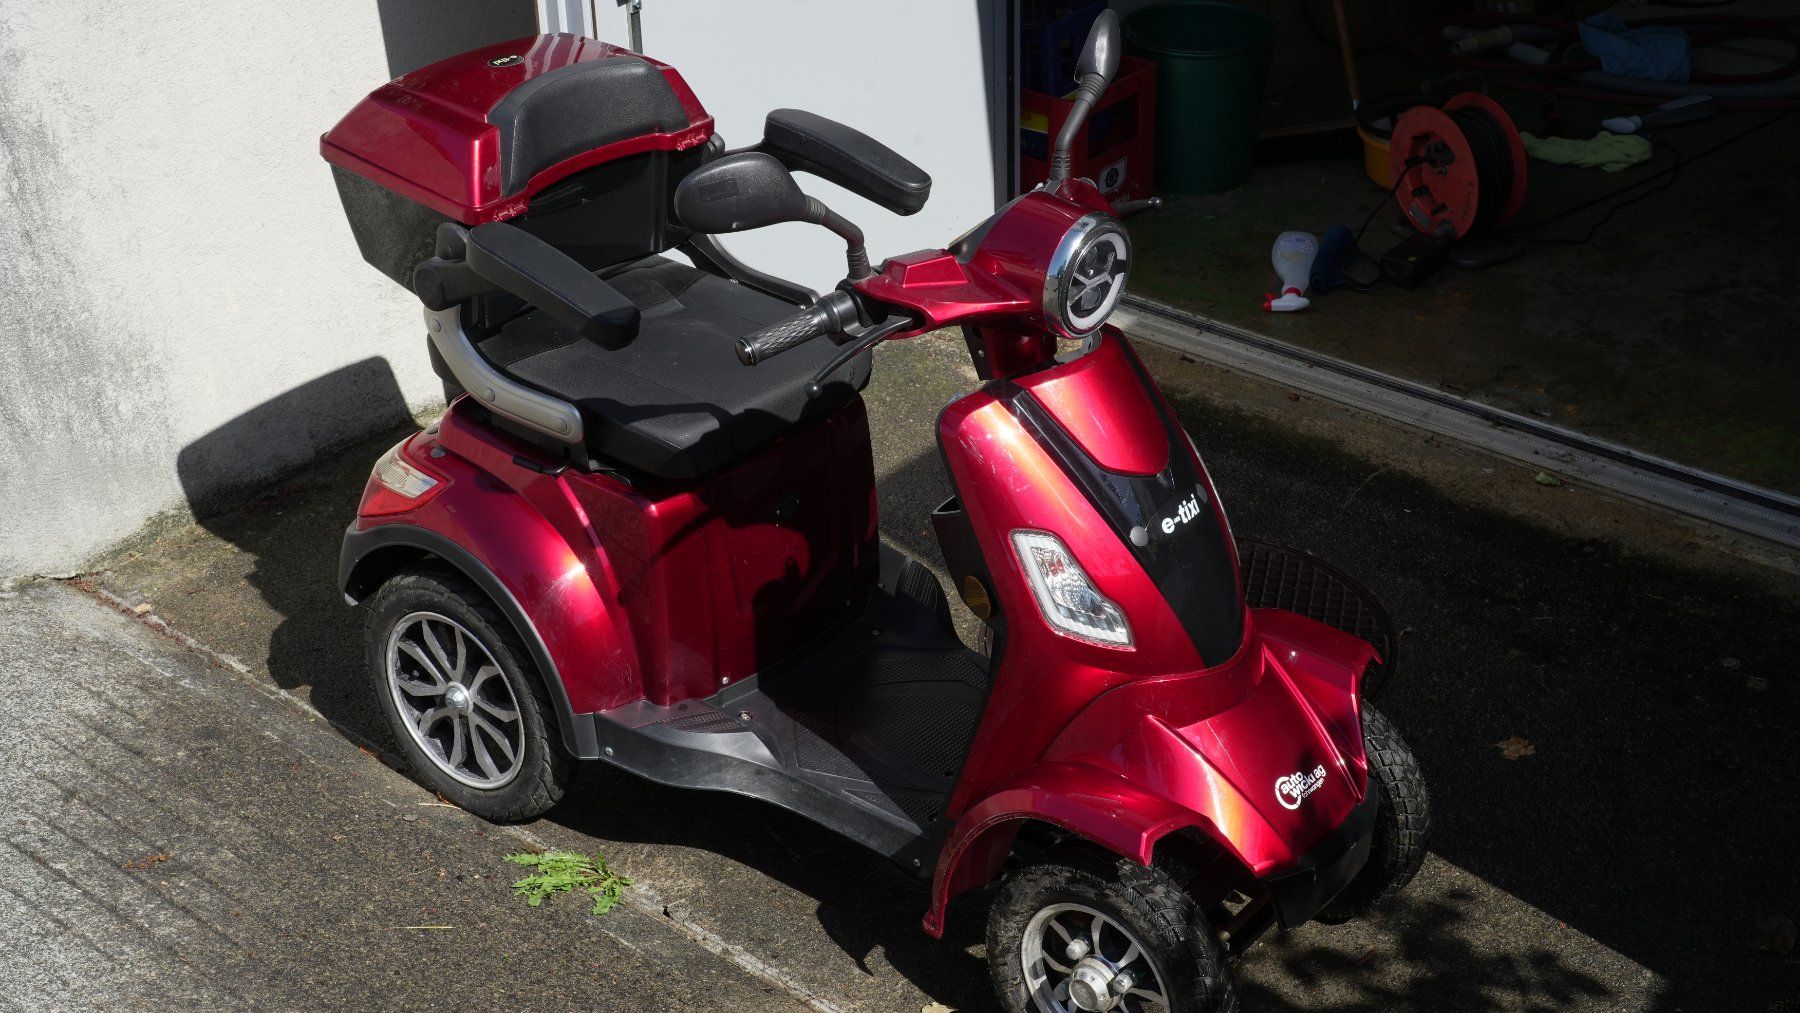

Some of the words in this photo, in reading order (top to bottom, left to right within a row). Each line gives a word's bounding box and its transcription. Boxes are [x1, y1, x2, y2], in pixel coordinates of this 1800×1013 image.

[1162, 493, 1200, 533] e-tixi
[1281, 772, 1303, 794] auto
[1289, 774, 1315, 798] wicki
[1314, 765, 1327, 778] ag
